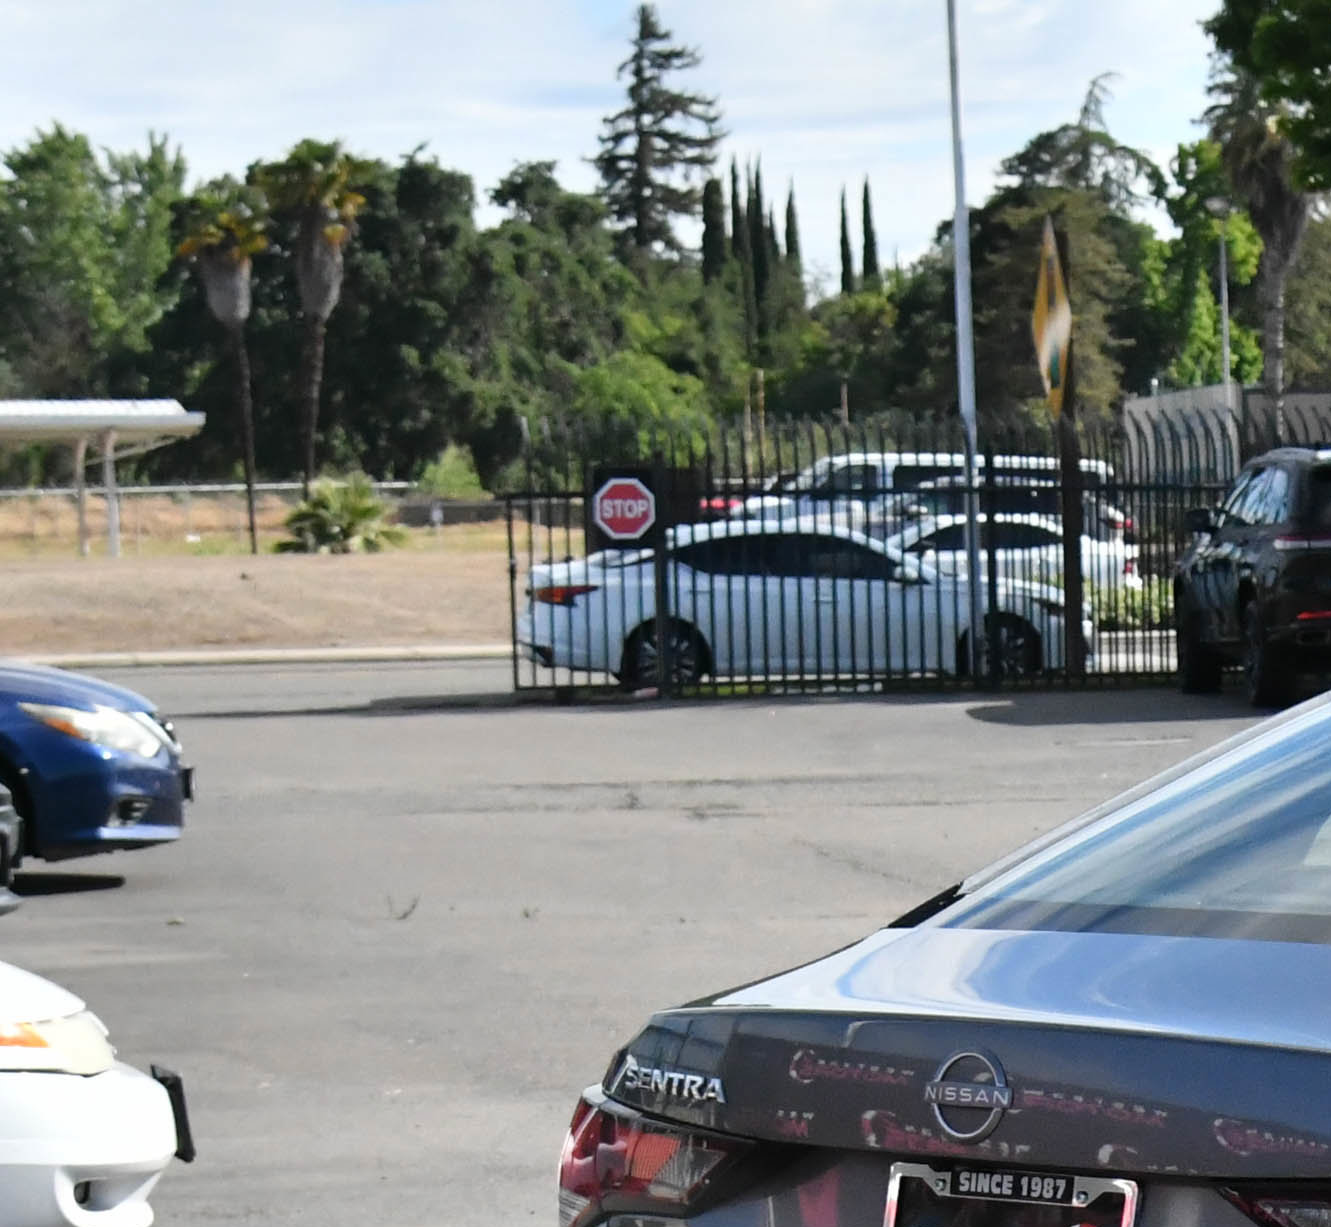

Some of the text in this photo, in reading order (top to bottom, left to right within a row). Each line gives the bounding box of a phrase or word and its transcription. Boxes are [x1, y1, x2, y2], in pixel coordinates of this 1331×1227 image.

[602, 499, 649, 519] STOP
[624, 1065, 726, 1103] SENTRA
[924, 1085, 1009, 1105] NISSAN
[958, 1171, 1067, 1200] SINCE 1987
